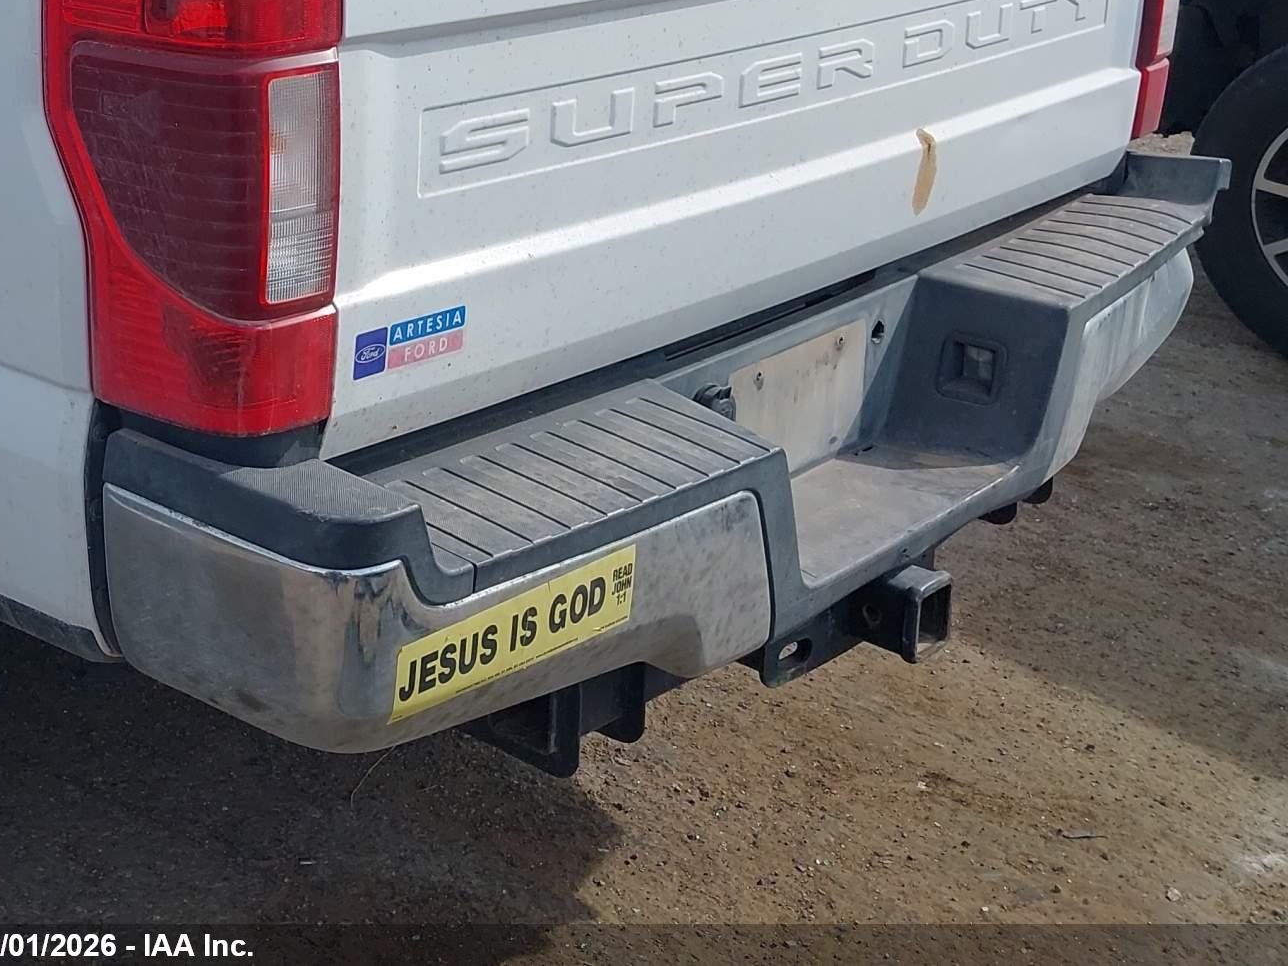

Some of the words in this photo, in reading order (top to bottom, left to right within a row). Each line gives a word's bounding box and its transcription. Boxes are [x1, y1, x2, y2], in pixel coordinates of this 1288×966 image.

[438, 37, 876, 175] SUPER
[393, 310, 462, 342] ARTESIA
[404, 337, 448, 362] FORD
[612, 562, 633, 583] READ
[611, 575, 633, 596] JOHN
[616, 591, 626, 606] 1:1
[398, 624, 498, 702] JESUS
[509, 606, 537, 652] IS
[548, 577, 606, 634] GOD
